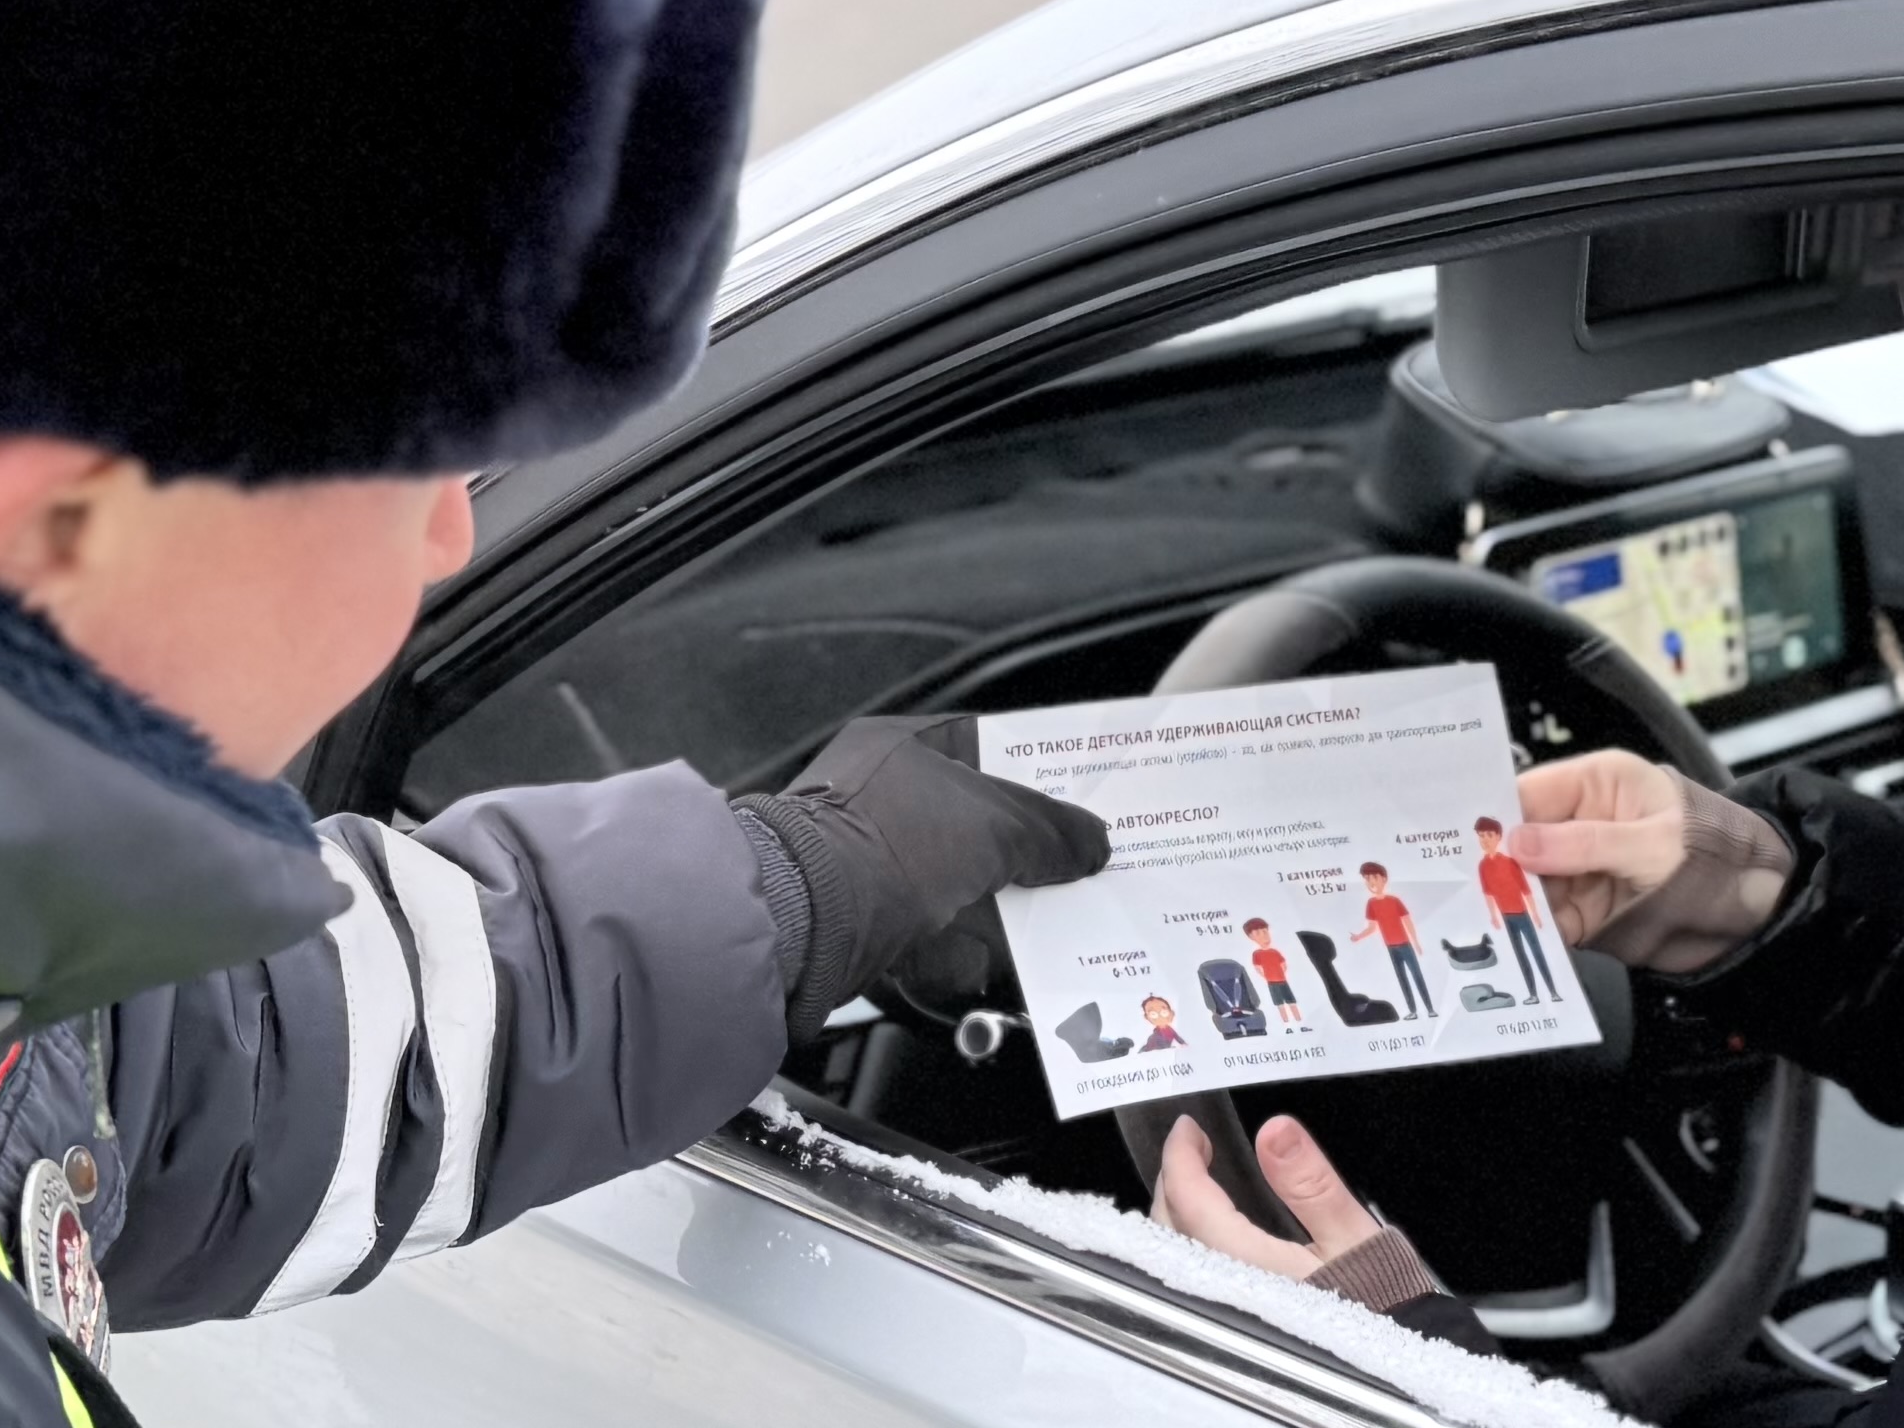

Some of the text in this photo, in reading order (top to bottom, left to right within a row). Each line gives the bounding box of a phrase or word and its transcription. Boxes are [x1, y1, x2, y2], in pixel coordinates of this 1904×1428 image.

[1005, 707, 1361, 758] ЧТО ТАКОЕ ДЕТСКАЯ УДЕРЖИВАЮЩАЯ СИСТЕМА?
[1116, 806, 1220, 830] АВТОКРЕСЛО?
[1404, 829, 1461, 845] категория
[1088, 949, 1147, 965] категория
[38, 1227, 54, 1298] МВД
